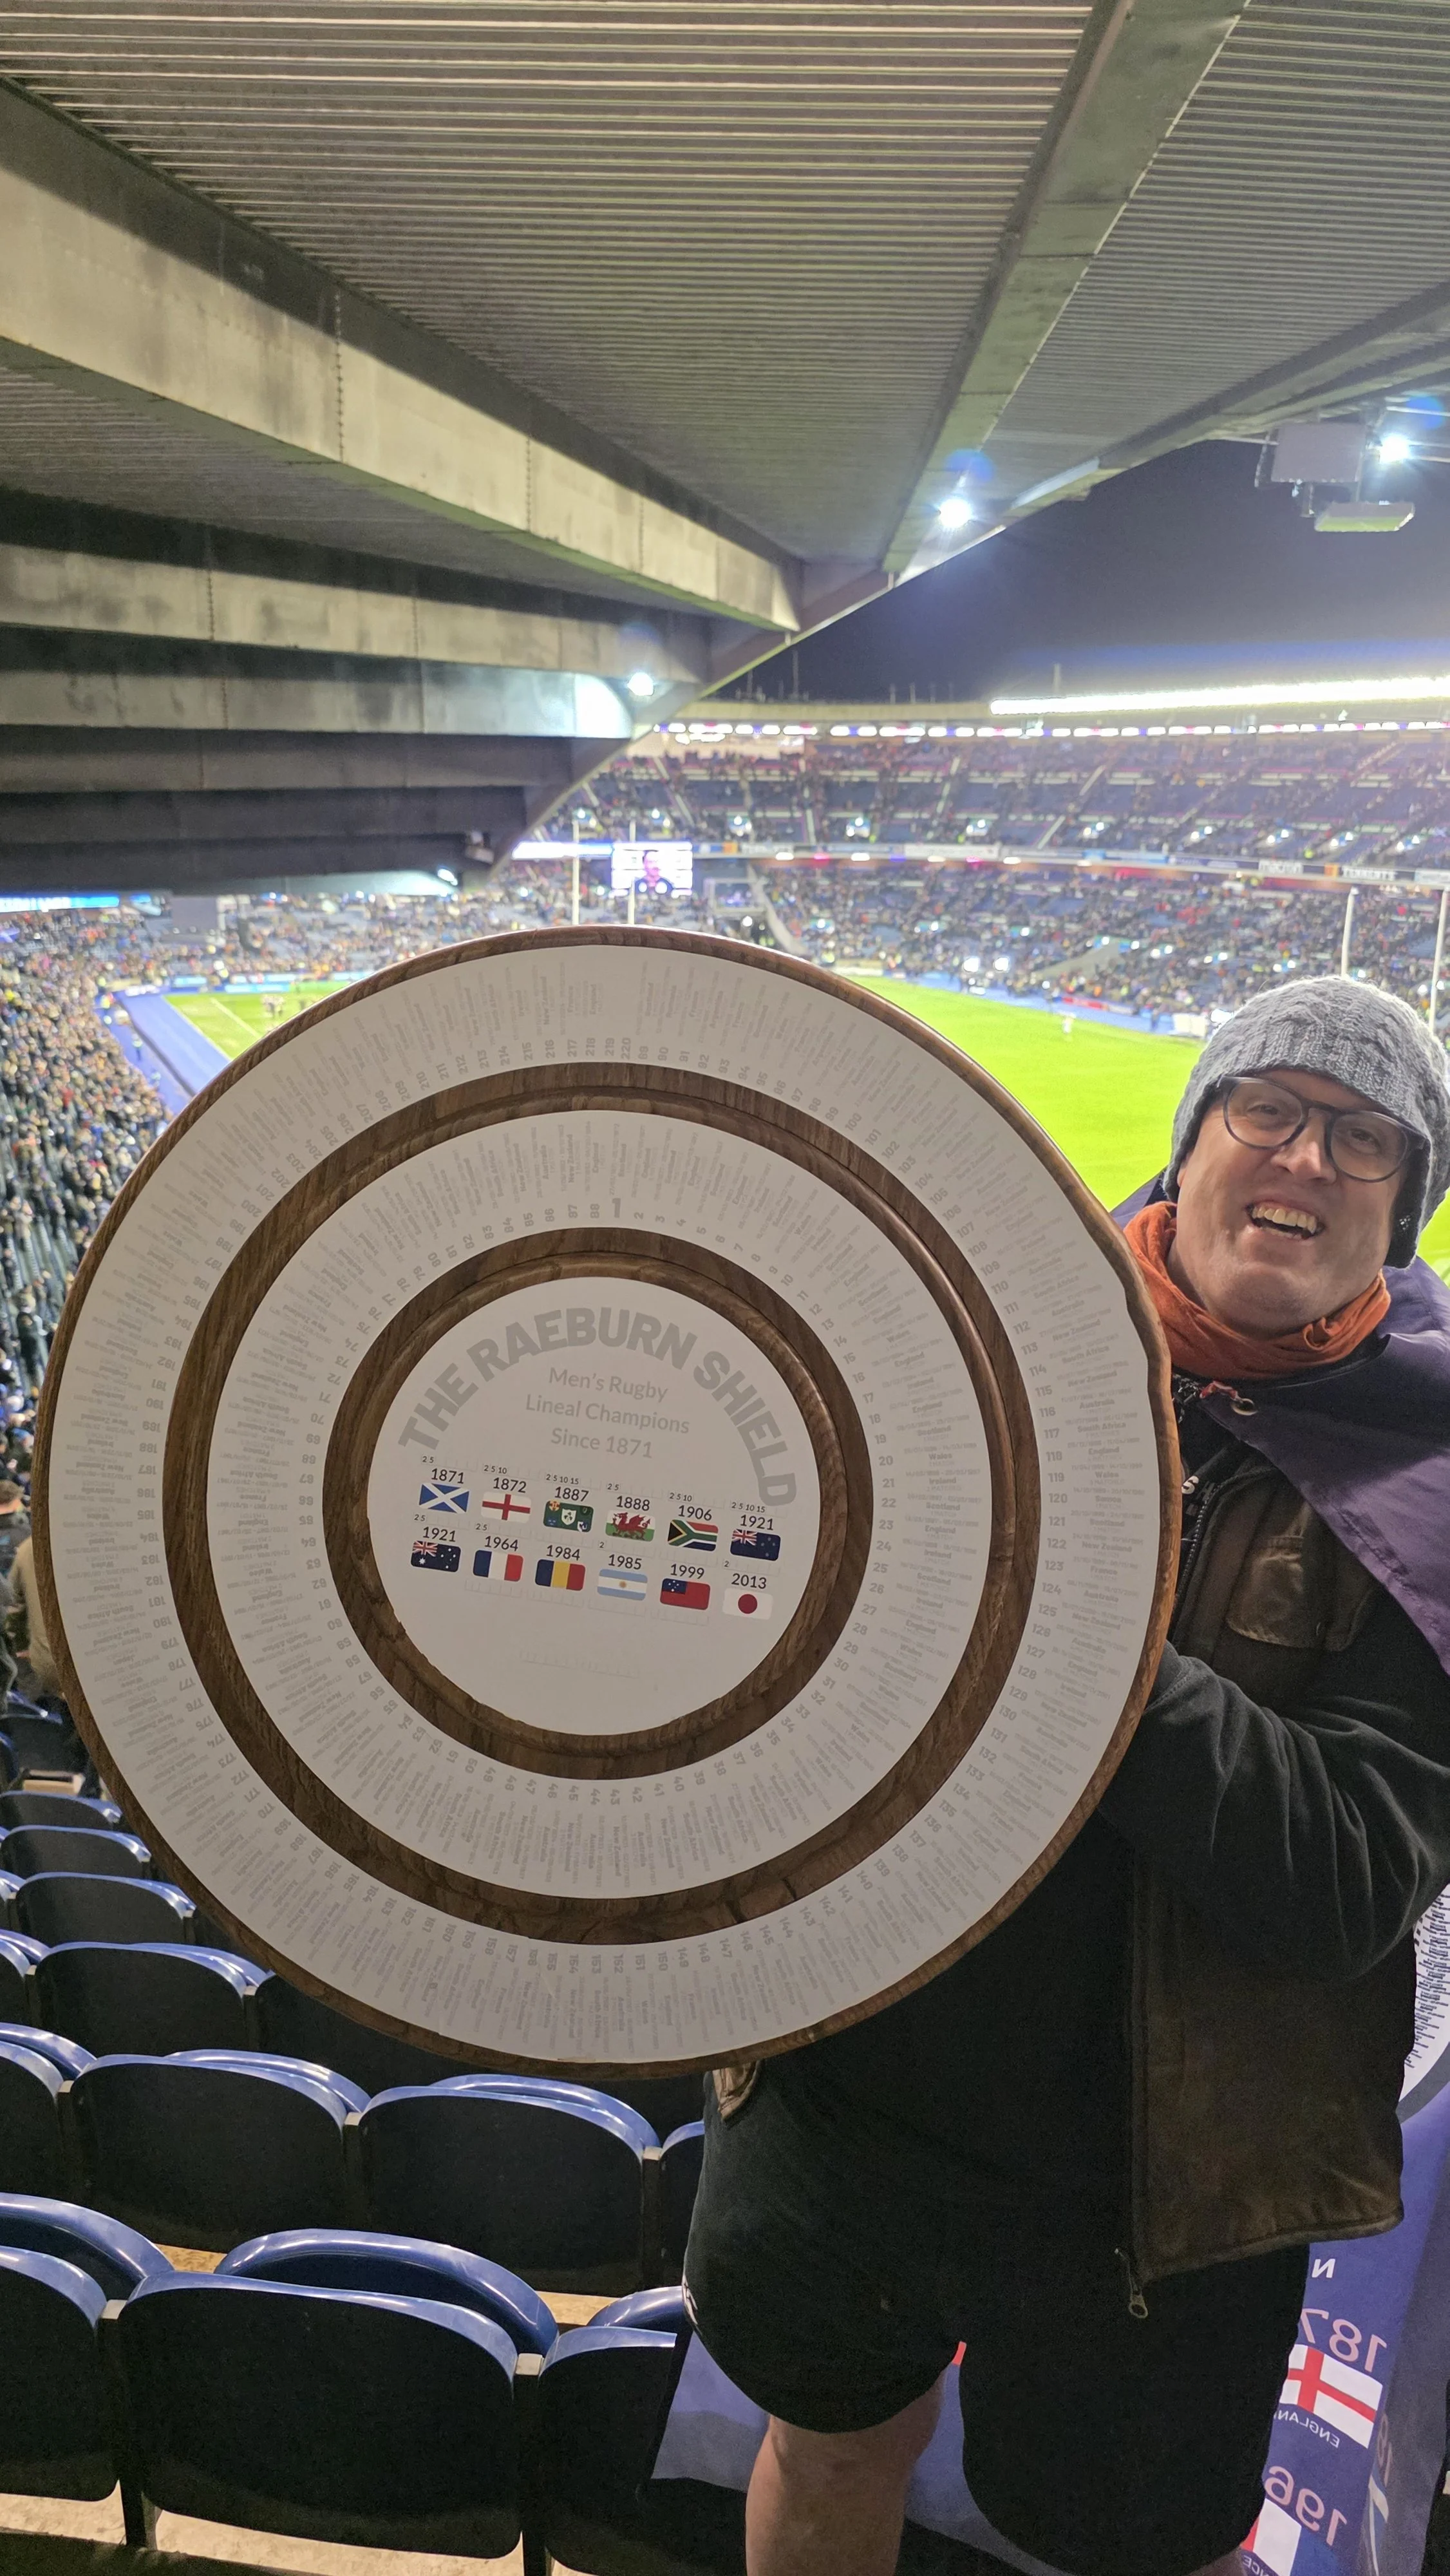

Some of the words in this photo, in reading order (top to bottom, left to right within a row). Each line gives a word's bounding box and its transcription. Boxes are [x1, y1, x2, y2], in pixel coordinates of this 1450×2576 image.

[498, 1045, 510, 1066] 214
[566, 1038, 577, 1057] 217
[620, 1037, 631, 1059] 220
[455, 1054, 468, 1074] 212
[476, 1049, 489, 1069] 213
[435, 1062, 449, 1081] 211
[844, 1112, 862, 1131] 100
[864, 1128, 881, 1146] 101
[304, 1138, 323, 1160] 204
[881, 1140, 900, 1159] 102
[898, 1154, 916, 1173] 103
[270, 1167, 290, 1188] 202
[914, 1172, 934, 1190] 104
[255, 1183, 275, 1201] 201
[240, 1199, 262, 1218] 200
[633, 1211, 644, 1220] 2
[654, 1215, 665, 1223] 3
[675, 1218, 686, 1227] 4
[695, 1226, 706, 1235] 5
[956, 1220, 974, 1238] 107
[733, 1242, 743, 1252] 7
[780, 1273, 793, 1287] 10
[381, 1293, 396, 1307] 77
[796, 1289, 809, 1301] 11
[808, 1302, 823, 1316] 12
[1003, 1301, 1019, 1314] 111
[355, 1320, 371, 1335] 75
[820, 1317, 834, 1331] 13
[1012, 1320, 1031, 1334] 112
[344, 1337, 359, 1352] 74
[833, 1334, 847, 1347] 14
[334, 1354, 350, 1368] 73
[1028, 1363, 1047, 1377] 114
[326, 1372, 341, 1386] 72
[318, 1390, 331, 1404] 71
[609, 1376, 668, 1403] Rugby
[862, 1391, 874, 1404] 17
[1034, 1384, 1053, 1397] 115
[398, 1362, 479, 1451] THE
[466, 1307, 698, 1382] RAEBURN
[693, 1350, 797, 1506] SHIELD
[525, 1394, 581, 1417] Lineal
[585, 1403, 690, 1434] Champions
[310, 1412, 325, 1425] 70
[1043, 1426, 1060, 1439] 117
[551, 1427, 600, 1451] Since
[606, 1435, 652, 1459] 1871
[878, 1454, 894, 1466] 20
[431, 1468, 464, 1484] 1871
[881, 1477, 895, 1488] 21
[493, 1477, 527, 1493] 1872
[554, 1486, 589, 1502] 1887
[616, 1495, 650, 1511] 1888
[881, 1497, 896, 1508] 22
[678, 1505, 712, 1521] 1906
[1048, 1515, 1066, 1526] 121
[740, 1514, 774, 1531] 1921
[878, 1519, 894, 1530] 23
[422, 1526, 456, 1542] 1921
[484, 1535, 519, 1551] 1964
[875, 1539, 892, 1552] 24
[1046, 1537, 1067, 1549] 122
[546, 1545, 581, 1561] 1984
[608, 1553, 642, 1570] 1985
[872, 1561, 889, 1574] 25
[1044, 1559, 1064, 1571] 123
[670, 1563, 705, 1579] 1999
[731, 1573, 767, 1589] 2013
[1041, 1582, 1062, 1595] 124
[860, 1602, 877, 1616] 27
[1026, 1643, 1046, 1658] 127
[833, 1656, 849, 1672] 30
[822, 1675, 836, 1689] 31
[810, 1689, 826, 1706] 32
[780, 1716, 795, 1734] 34
[206, 1732, 226, 1748] 174
[217, 1752, 237, 1768] 173
[732, 1750, 746, 1765] 37
[978, 1745, 997, 1765] 132
[230, 1769, 250, 1786] 172
[673, 1776, 684, 1792] 40
[243, 1786, 261, 1803] 171
[525, 1778, 537, 1795] 47
[567, 1785, 579, 1801] 45
[631, 1786, 643, 1803] 42
[653, 1782, 665, 1797] 41
[952, 1782, 970, 1801] 134
[590, 1788, 601, 1806] 44
[609, 1788, 620, 1805] 43
[909, 1829, 927, 1848] 137
[818, 1895, 836, 1917] 142
[778, 1916, 794, 1938] 144
[719, 1937, 733, 1958] 147
